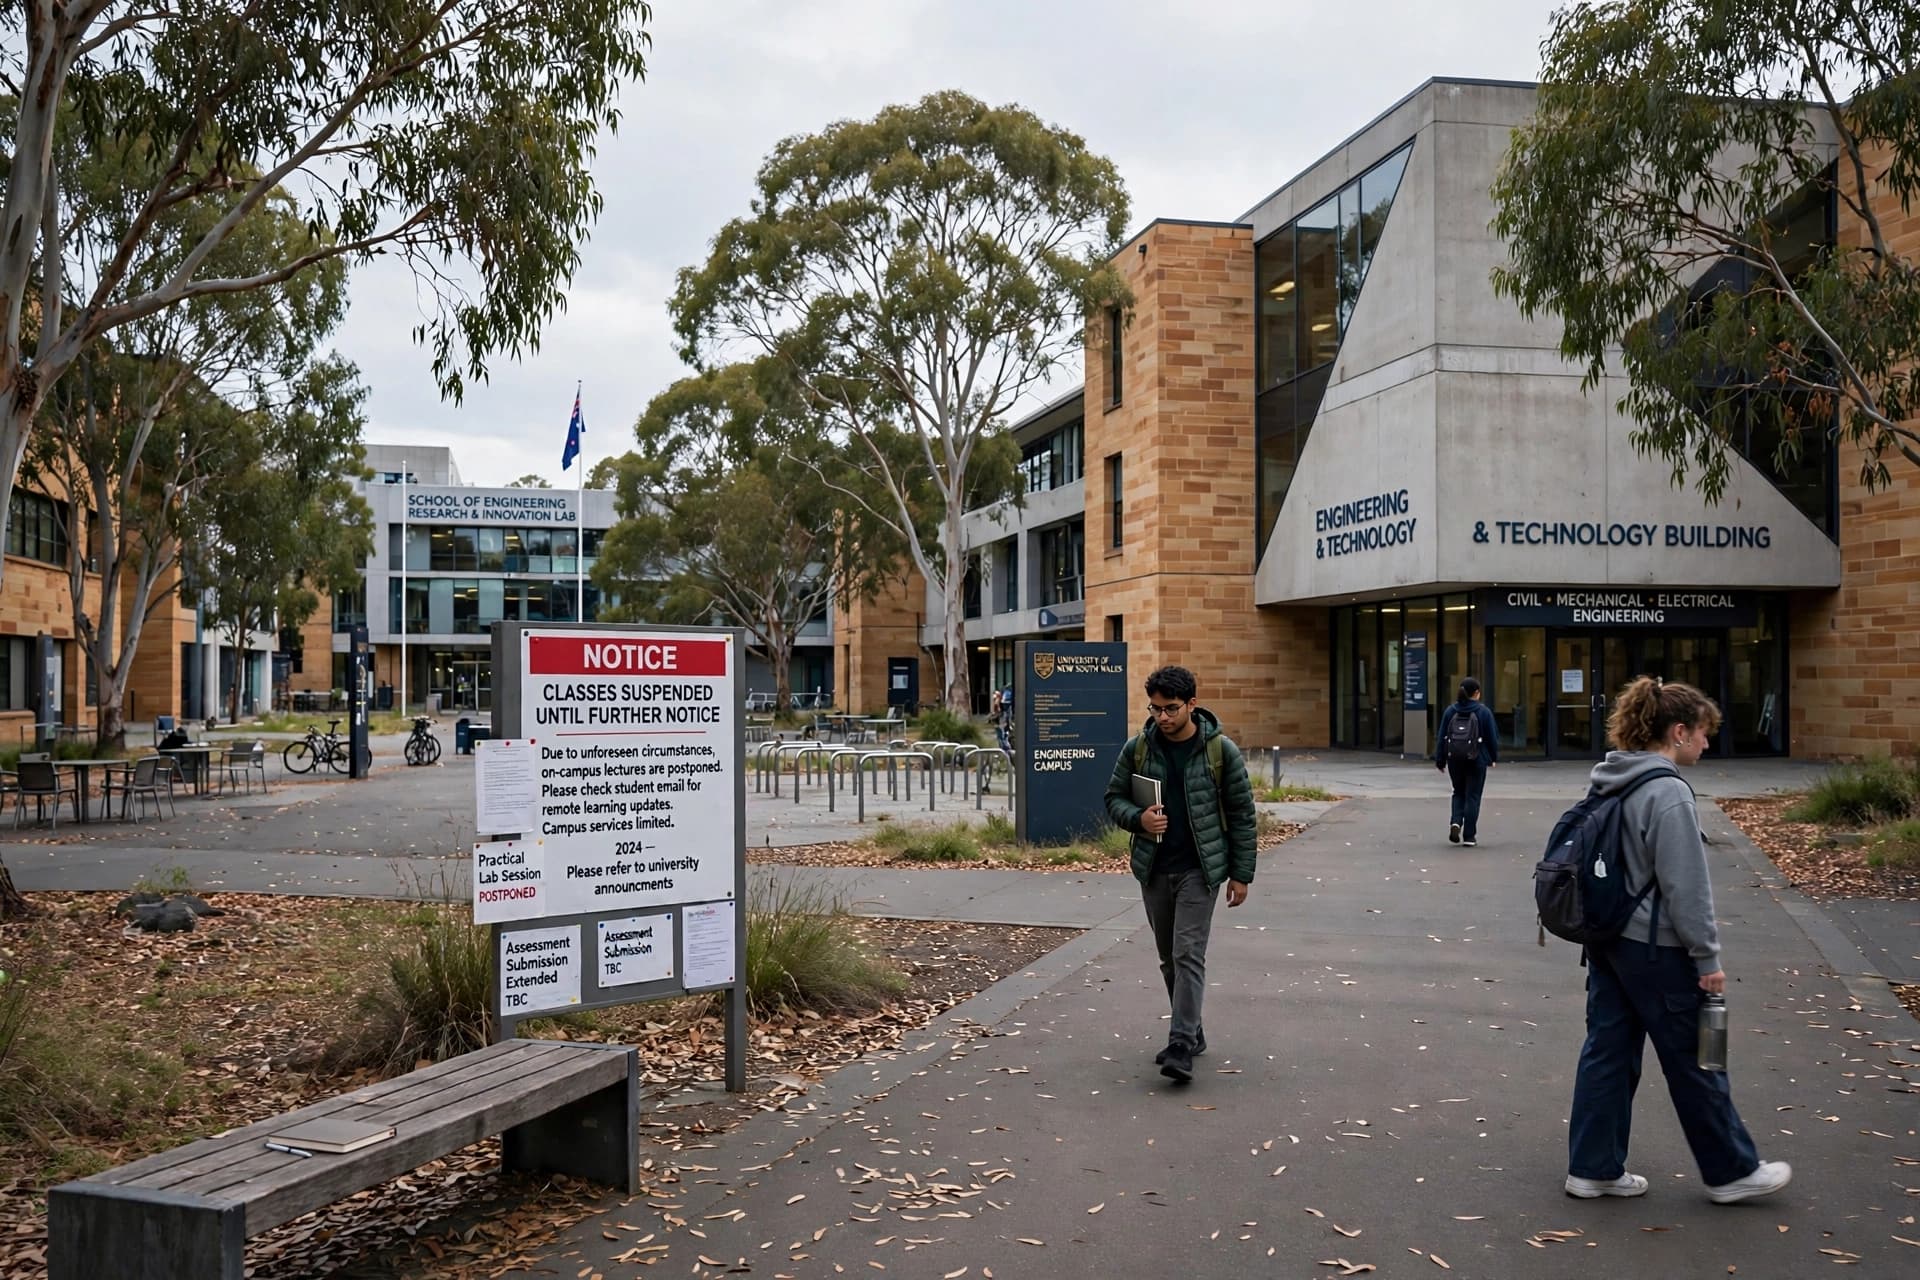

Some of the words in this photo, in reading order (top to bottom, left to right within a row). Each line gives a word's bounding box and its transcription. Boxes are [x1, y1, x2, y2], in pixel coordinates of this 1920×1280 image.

[408, 494, 460, 507] SCHOOL
[463, 496, 480, 507] OF
[483, 497, 566, 510] ENGINEERING
[408, 508, 468, 519] RESEARCH
[471, 509, 479, 519] &
[482, 510, 551, 521] INNOVATION
[554, 511, 576, 521] LAB
[1315, 489, 1409, 533] ENGINEERING
[1316, 538, 1325, 560] &
[1327, 518, 1417, 558] TECHNOLOGY
[1472, 521, 1490, 544] &
[1495, 521, 1658, 546] TECHNOLOGY
[1665, 524, 1771, 549] BUILDING
[1507, 592, 1542, 607] CIVIL
[1556, 592, 1645, 608] MECHANICAL
[1657, 594, 1736, 609] ELECTRICAL
[1572, 608, 1665, 623] ENGINEERING
[583, 643, 678, 670] NOTICE
[543, 684, 617, 701] CLASSES
[621, 684, 713, 701] SUSPENDED
[536, 707, 584, 725] UNTIL
[588, 706, 662, 724] FURTHER
[666, 706, 720, 723] NOTICE
[541, 747, 563, 760] Due
[566, 746, 577, 759] to
[580, 745, 638, 759] unforeseen
[641, 743, 716, 758] circumstances,
[1034, 748, 1095, 760] ENGINEERING
[541, 764, 602, 782] on-campus
[604, 762, 646, 777] lectures
[649, 765, 665, 775] are
[667, 760, 723, 780] postponed.
[1034, 760, 1072, 771] CAMPUS
[541, 783, 577, 797] Please
[580, 781, 612, 795] check
[614, 780, 655, 794] student
[657, 779, 685, 792] email
[687, 779, 702, 791] for
[542, 803, 581, 816] remote
[583, 800, 627, 817] learning
[630, 799, 673, 815] updates.
[542, 821, 587, 837] Campus
[589, 819, 633, 832] services
[635, 816, 675, 830] limited.
[615, 841, 642, 855] 2024
[478, 851, 525, 867] Practical
[567, 864, 603, 879] Please
[605, 862, 632, 876] refer
[634, 862, 645, 874] to
[648, 856, 700, 873] university
[479, 870, 498, 884] Lab
[501, 867, 541, 882] Session
[594, 876, 674, 895] announcments
[479, 886, 536, 903] POSTPONED
[505, 936, 570, 955] Assessment
[506, 953, 569, 972] Submission
[605, 962, 622, 975] TBC
[506, 971, 558, 990] Extended
[505, 992, 529, 1007] TBC
